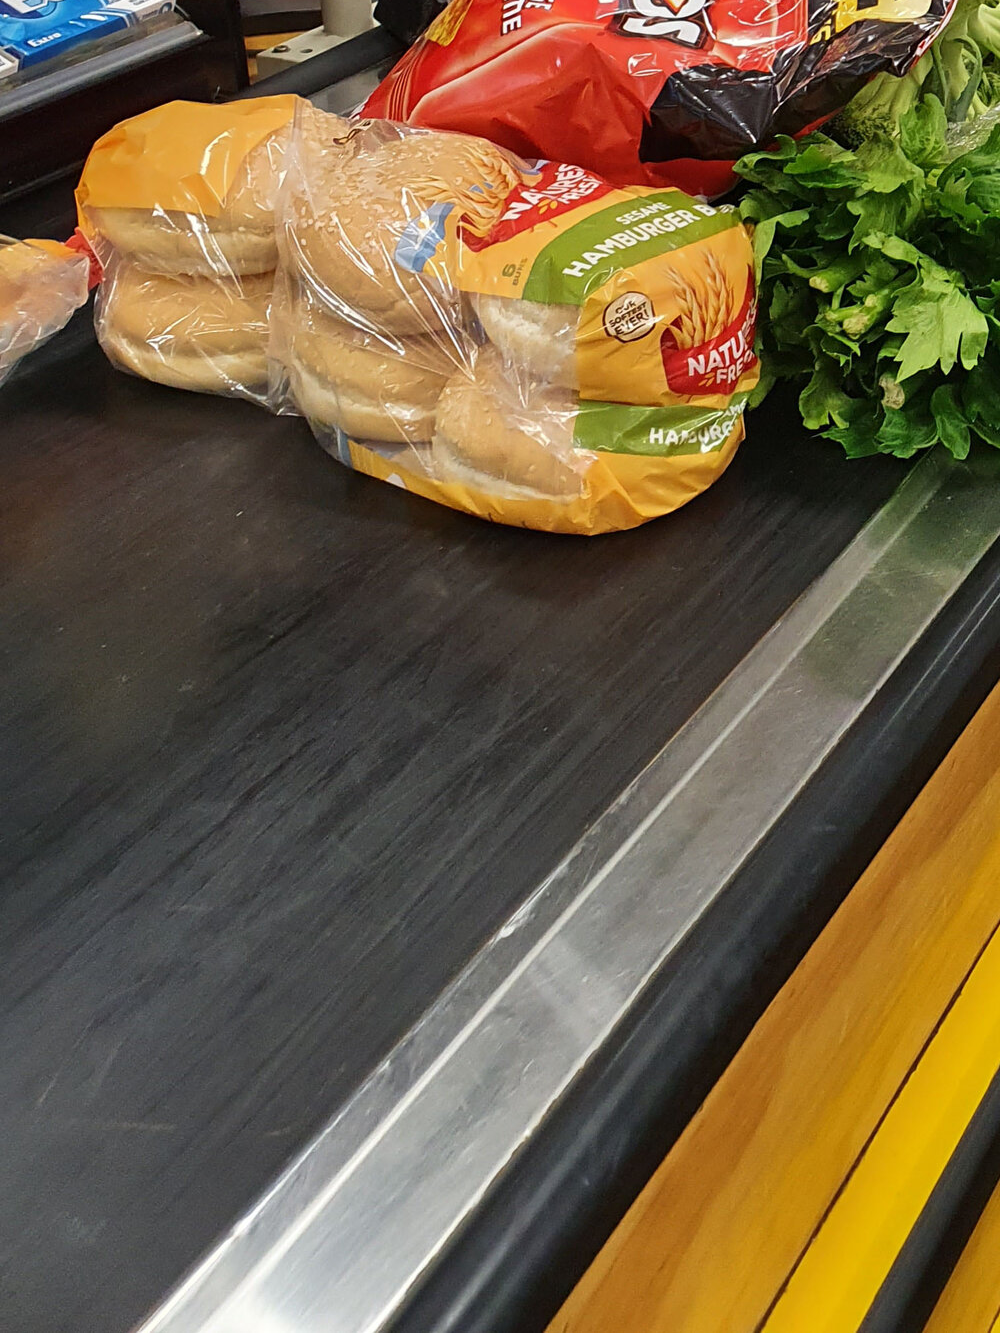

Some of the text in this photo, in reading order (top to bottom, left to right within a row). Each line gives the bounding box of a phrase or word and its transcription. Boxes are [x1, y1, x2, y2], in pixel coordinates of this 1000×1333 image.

[27, 32, 62, 48] Extra
[499, 163, 585, 221] NAURE'S
[616, 201, 672, 226] SESAME
[562, 209, 701, 278] HAMBURGER
[608, 301, 648, 328] SOFTEST
[614, 310, 650, 336] EVER!
[716, 350, 755, 385] FRE
